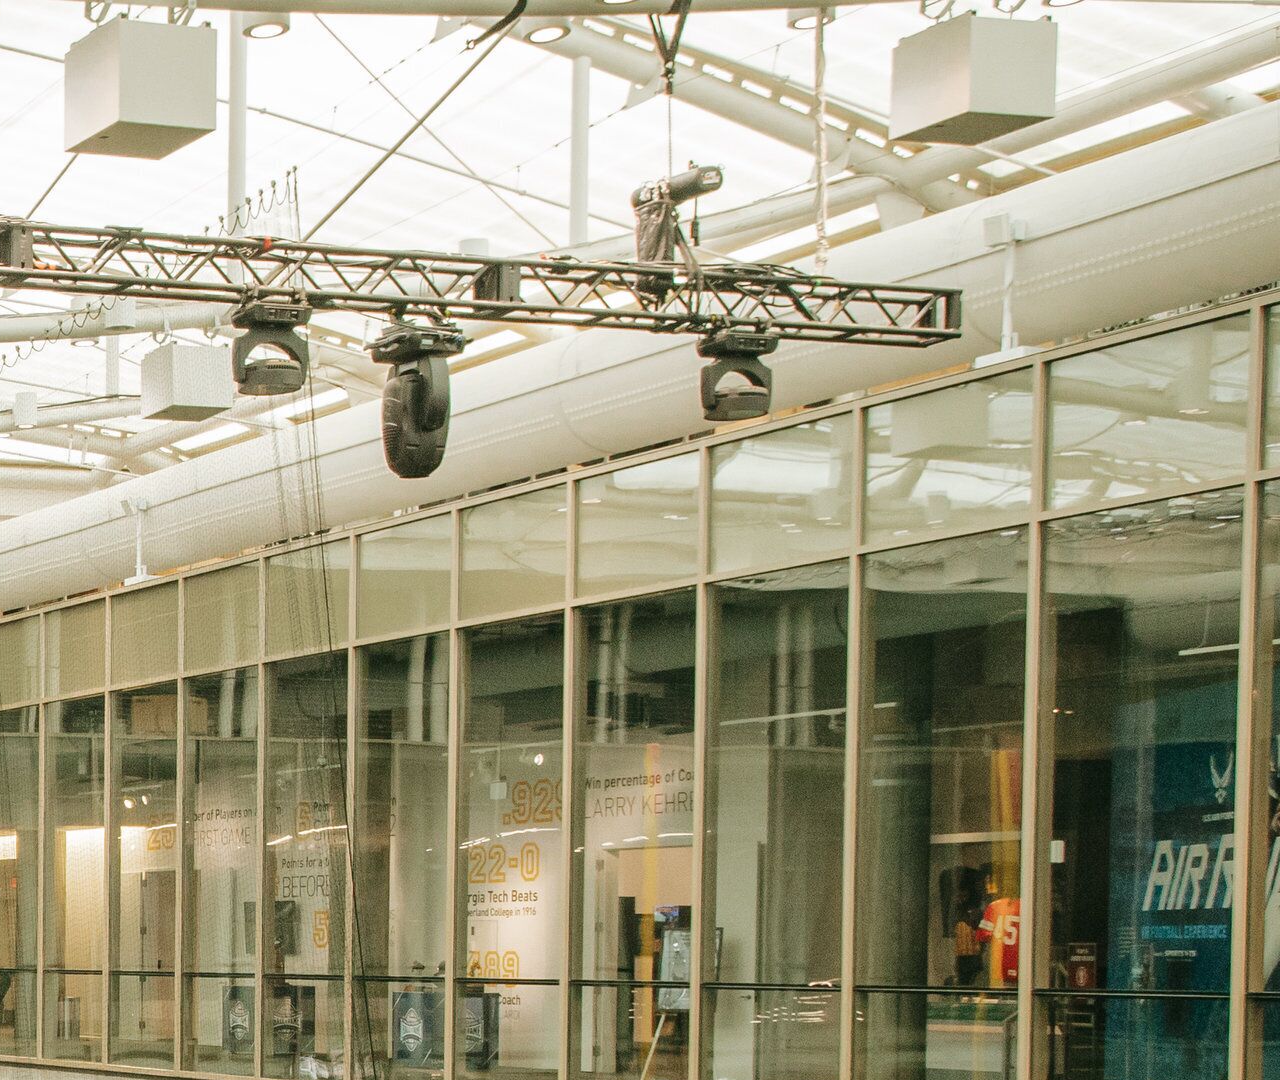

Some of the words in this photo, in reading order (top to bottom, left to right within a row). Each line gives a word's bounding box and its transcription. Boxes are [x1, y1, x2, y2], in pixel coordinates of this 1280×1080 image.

[605, 773, 661, 792] percentage
[665, 772, 676, 783] of
[502, 778, 562, 825] .92
[1142, 840, 1210, 911] AIR
[488, 890, 508, 903] Tech
[511, 889, 538, 902] Beats
[500, 995, 521, 1005] oach
